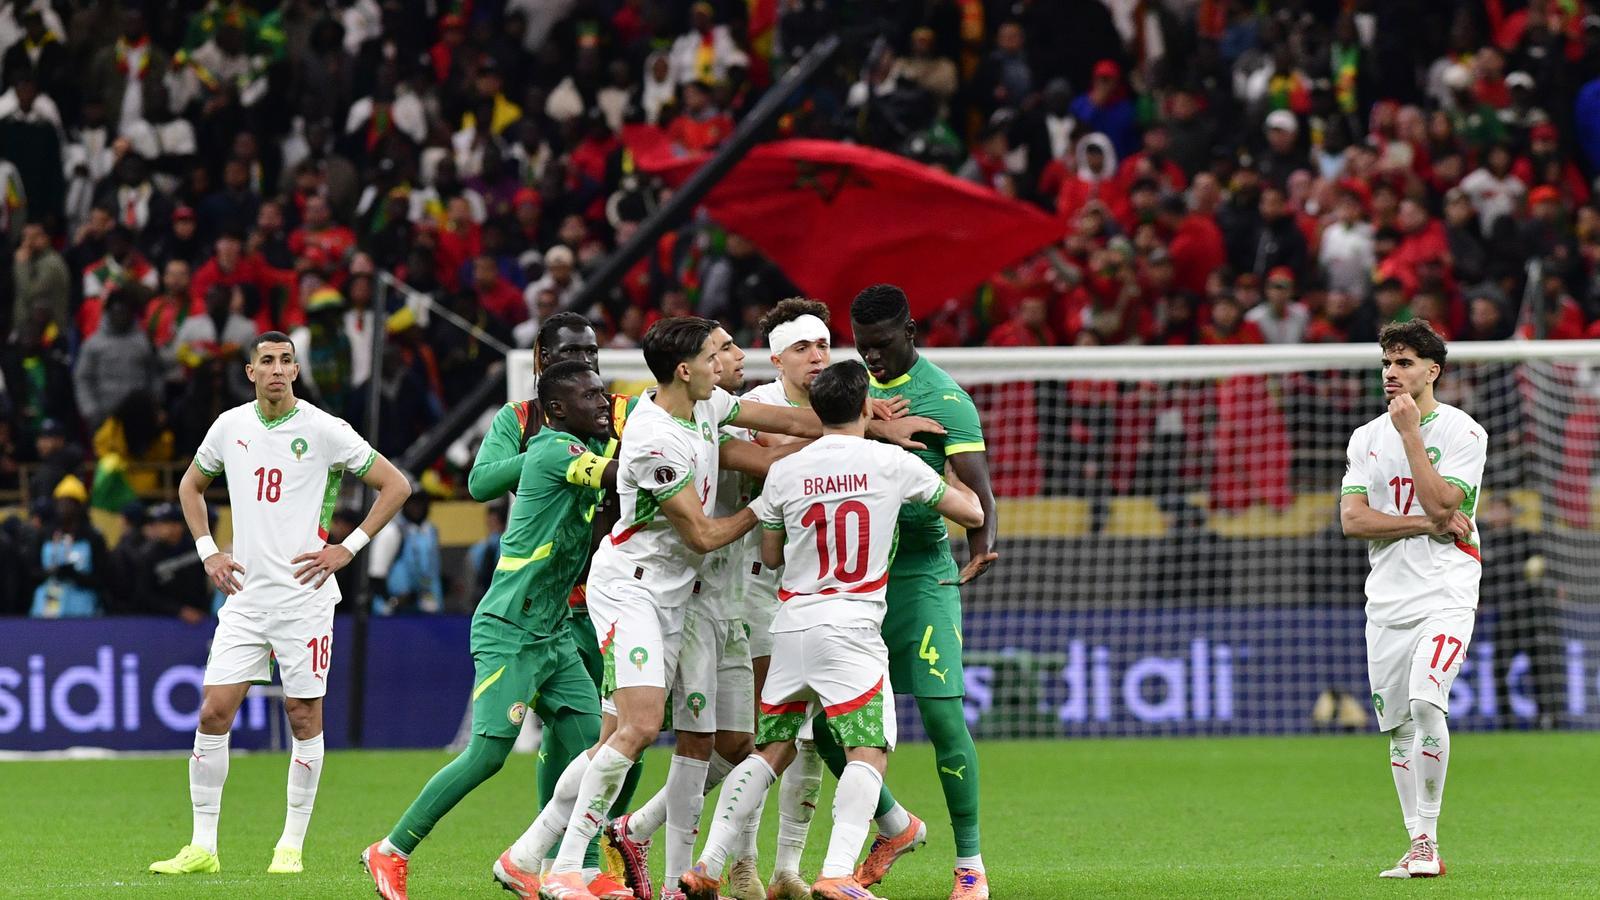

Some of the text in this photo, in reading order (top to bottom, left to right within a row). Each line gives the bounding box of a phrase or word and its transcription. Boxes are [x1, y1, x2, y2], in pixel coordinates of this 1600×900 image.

[254, 467, 283, 503] 18
[803, 473, 868, 496] BRAHIM
[1388, 476, 1416, 515] 17
[801, 500, 870, 583] 10
[307, 635, 329, 672] 18
[919, 625, 939, 665] 4
[1432, 633, 1462, 672] 17
[152, 664, 267, 731] ai
[1123, 636, 1233, 722] ali
